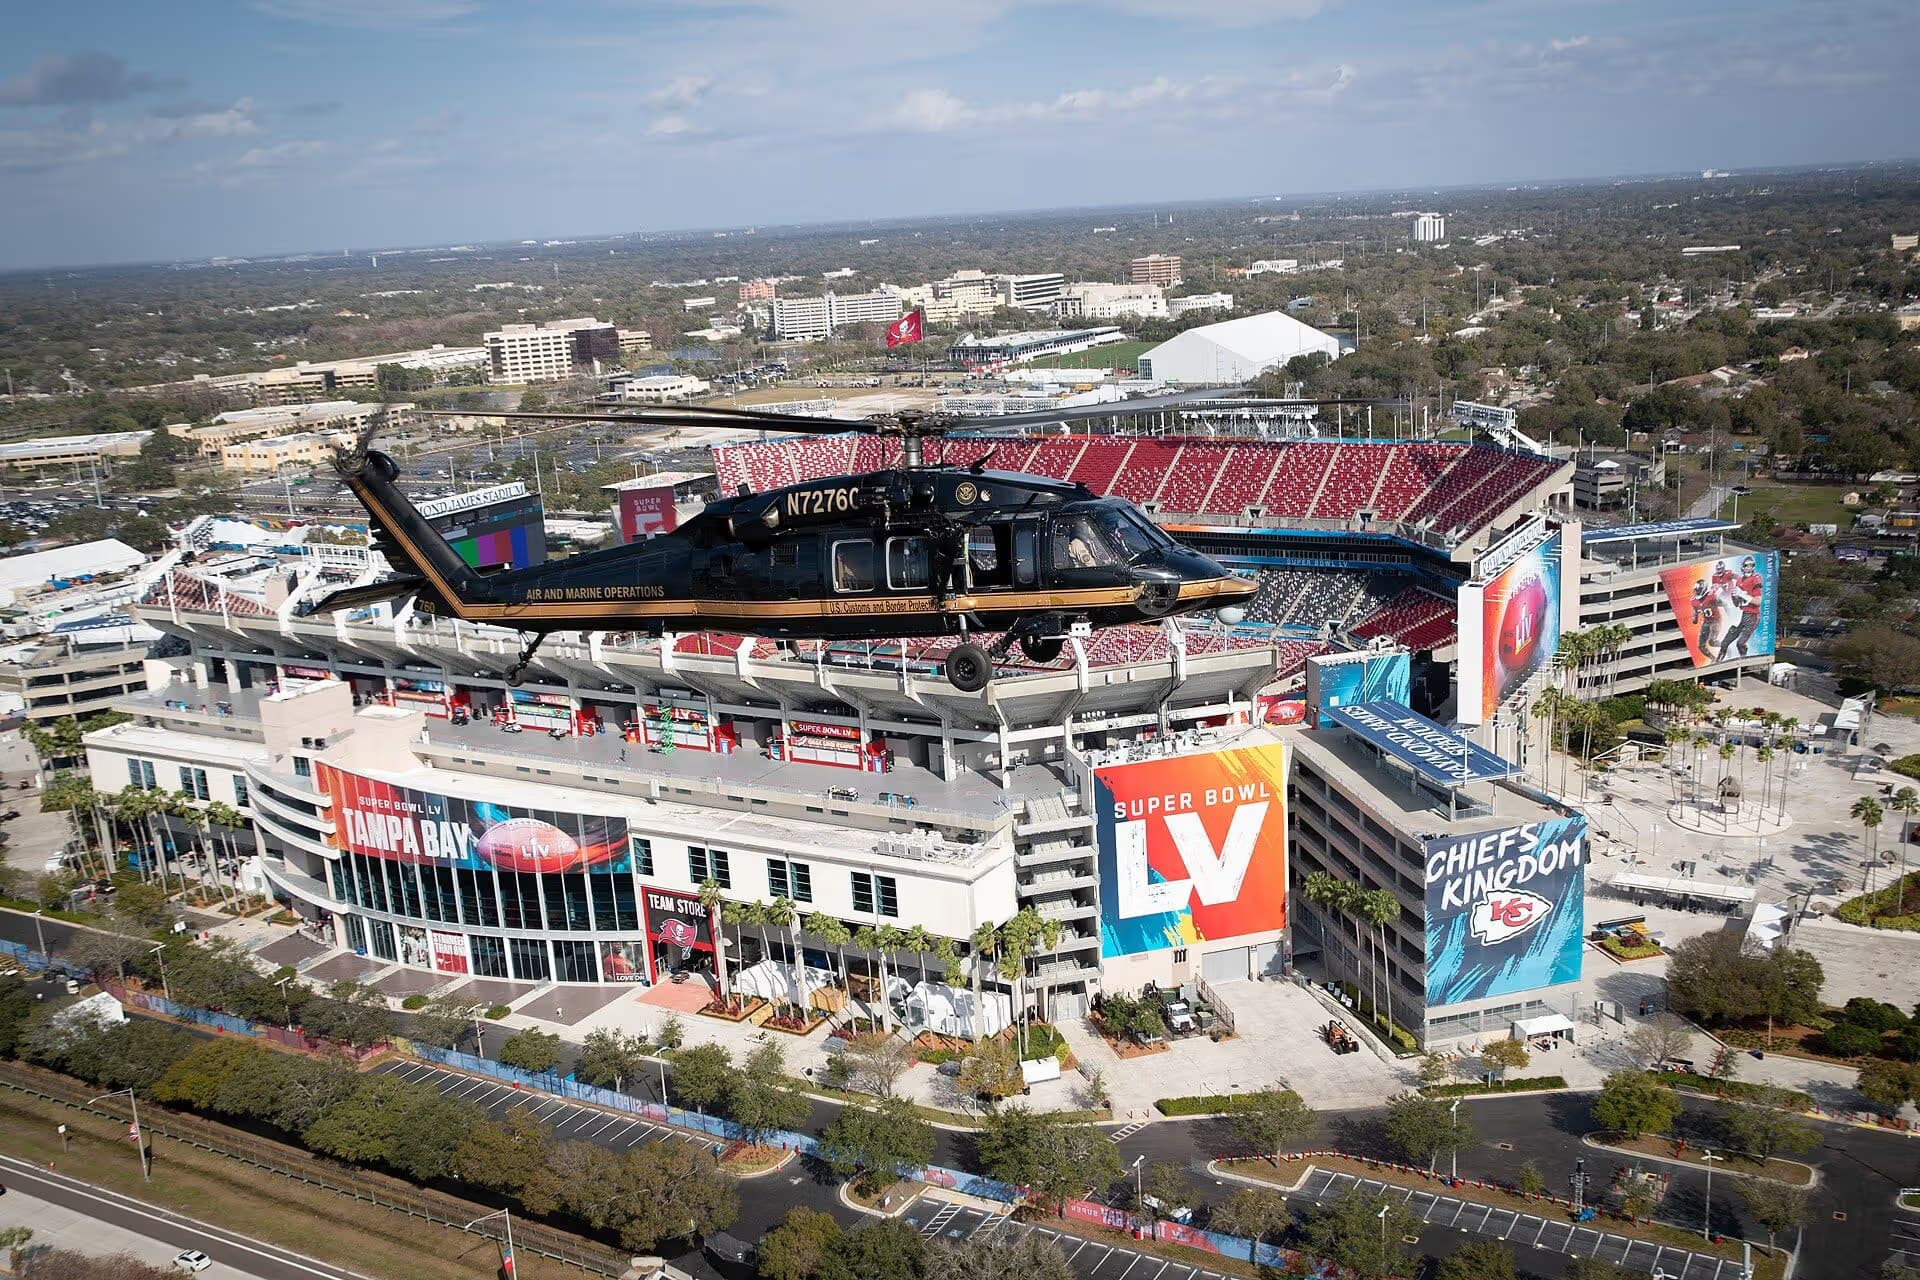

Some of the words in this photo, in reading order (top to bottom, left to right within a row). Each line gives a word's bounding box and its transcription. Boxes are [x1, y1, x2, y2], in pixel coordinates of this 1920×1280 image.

[450, 495, 481, 511] JAMES
[483, 484, 524, 504] STADIUM
[633, 497, 661, 506] SUPER
[636, 504, 660, 512] BOWL
[1286, 558, 1311, 566] SUPER
[1314, 559, 1336, 568] BOWL
[419, 599, 435, 613] 760
[526, 589, 542, 600] AIR
[544, 588, 563, 600] AND
[565, 587, 602, 599] MARINE
[604, 586, 664, 599] OPERATIONS
[830, 601, 843, 614] U.S.
[844, 601, 871, 613] Customs
[872, 600, 884, 612] and
[886, 600, 907, 612] Border
[909, 598, 938, 611] Protecti
[799, 724, 821, 733] SUPER
[822, 727, 841, 735] BOWL
[1338, 705, 1394, 733] JAMES
[1392, 717, 1474, 756] STADIUM
[1385, 732, 1479, 779] RAYMOND
[359, 796, 391, 808] SUPER
[394, 802, 424, 813] BOWL
[429, 805, 441, 815] LV
[1114, 792, 1192, 819] SUPER
[1205, 781, 1270, 806] BOWL
[342, 807, 420, 855] TAMPA
[421, 820, 469, 860] BAY
[1115, 800, 1270, 919] LV
[1426, 823, 1540, 883] CHIEFS
[1441, 837, 1581, 911] KINGDOM
[648, 894, 675, 912] TEAM
[677, 899, 707, 917] STORE
[1490, 898, 1533, 927] KC
